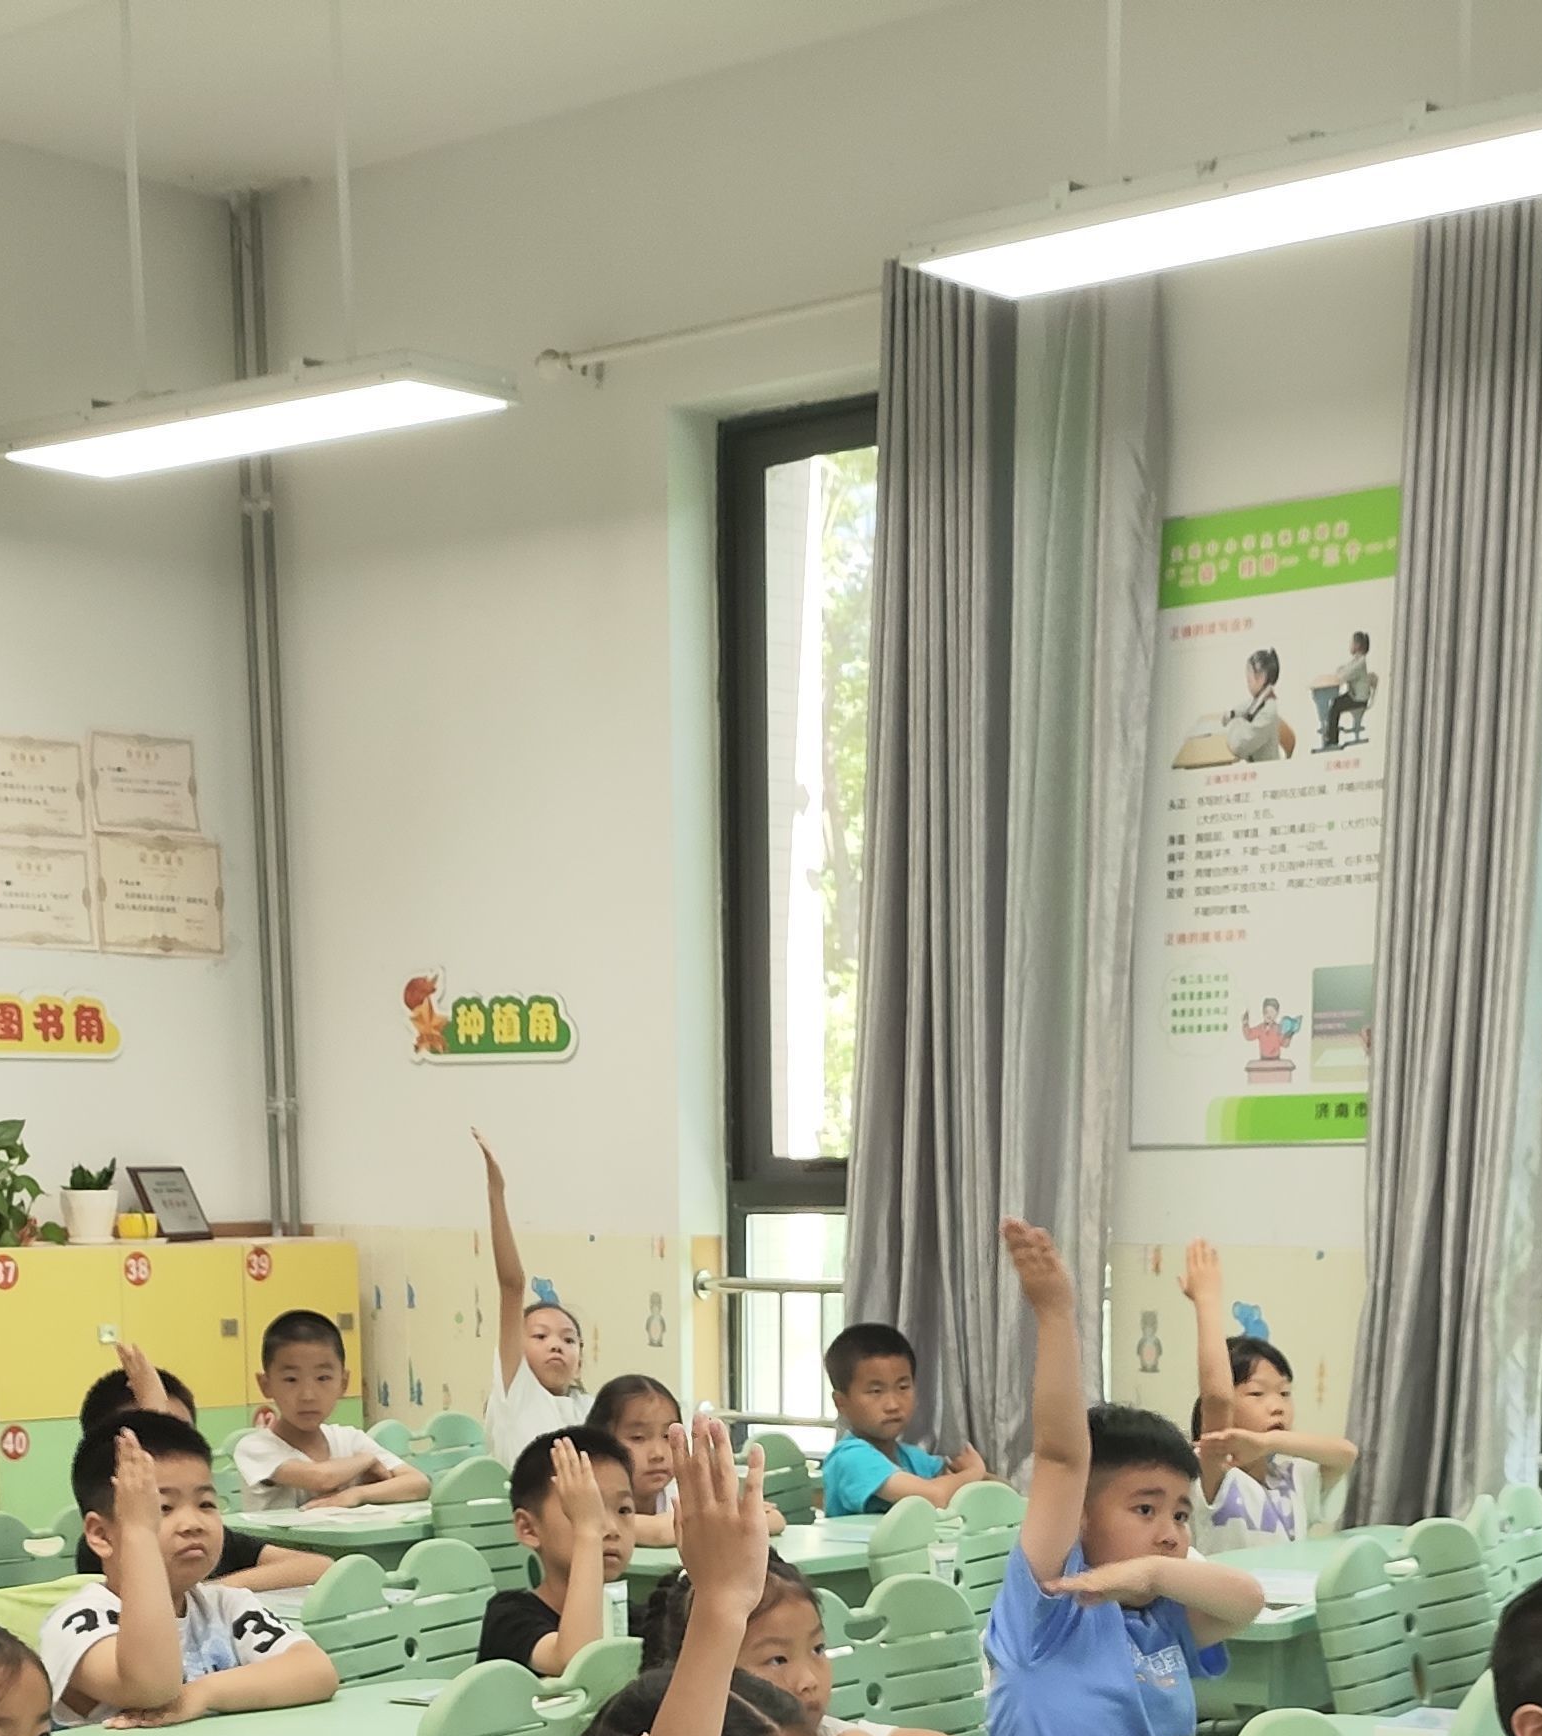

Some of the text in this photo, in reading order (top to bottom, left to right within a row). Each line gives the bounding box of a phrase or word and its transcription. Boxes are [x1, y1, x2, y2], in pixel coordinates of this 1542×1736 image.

[456, 1001, 558, 1045] 种植角
[125, 1258, 151, 1282] 38
[247, 1253, 271, 1278] 39
[2, 1431, 26, 1454] 40
